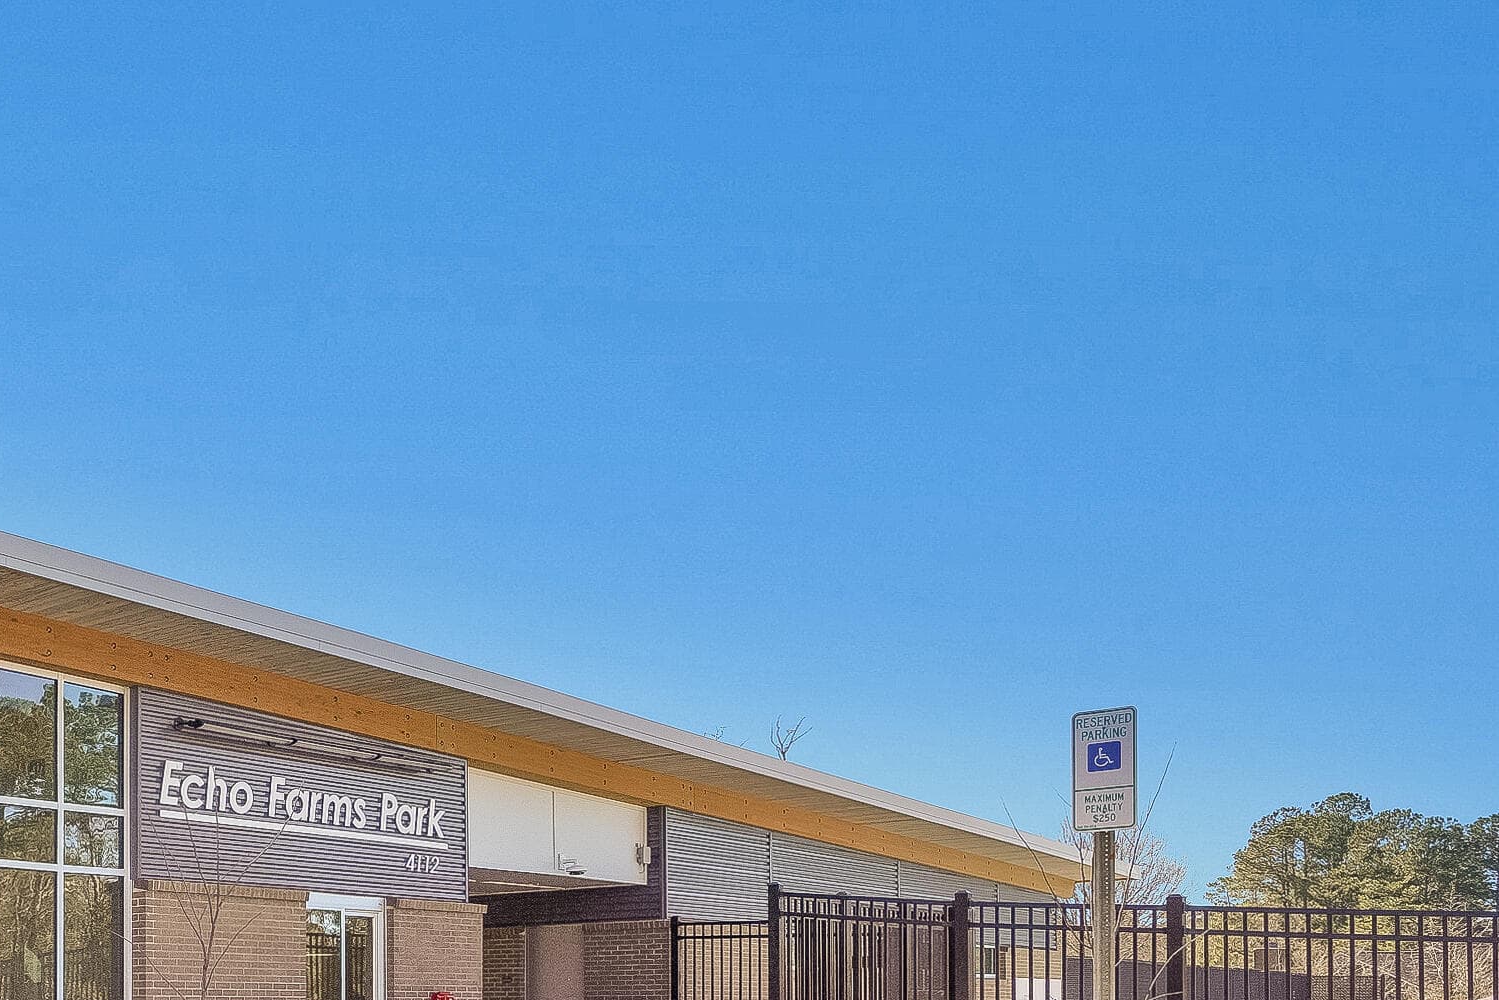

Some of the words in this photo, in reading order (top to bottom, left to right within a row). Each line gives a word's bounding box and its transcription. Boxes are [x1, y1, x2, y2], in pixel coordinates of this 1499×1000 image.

[1076, 713, 1132, 729] RESERVED
[1081, 726, 1127, 741] PARKING
[159, 759, 253, 814] Echo
[269, 776, 366, 829] Farms
[380, 792, 447, 839] Park
[1084, 793, 1124, 804] MAXIMUM
[1085, 802, 1123, 814] PENALTY
[405, 854, 441, 874] 4112
